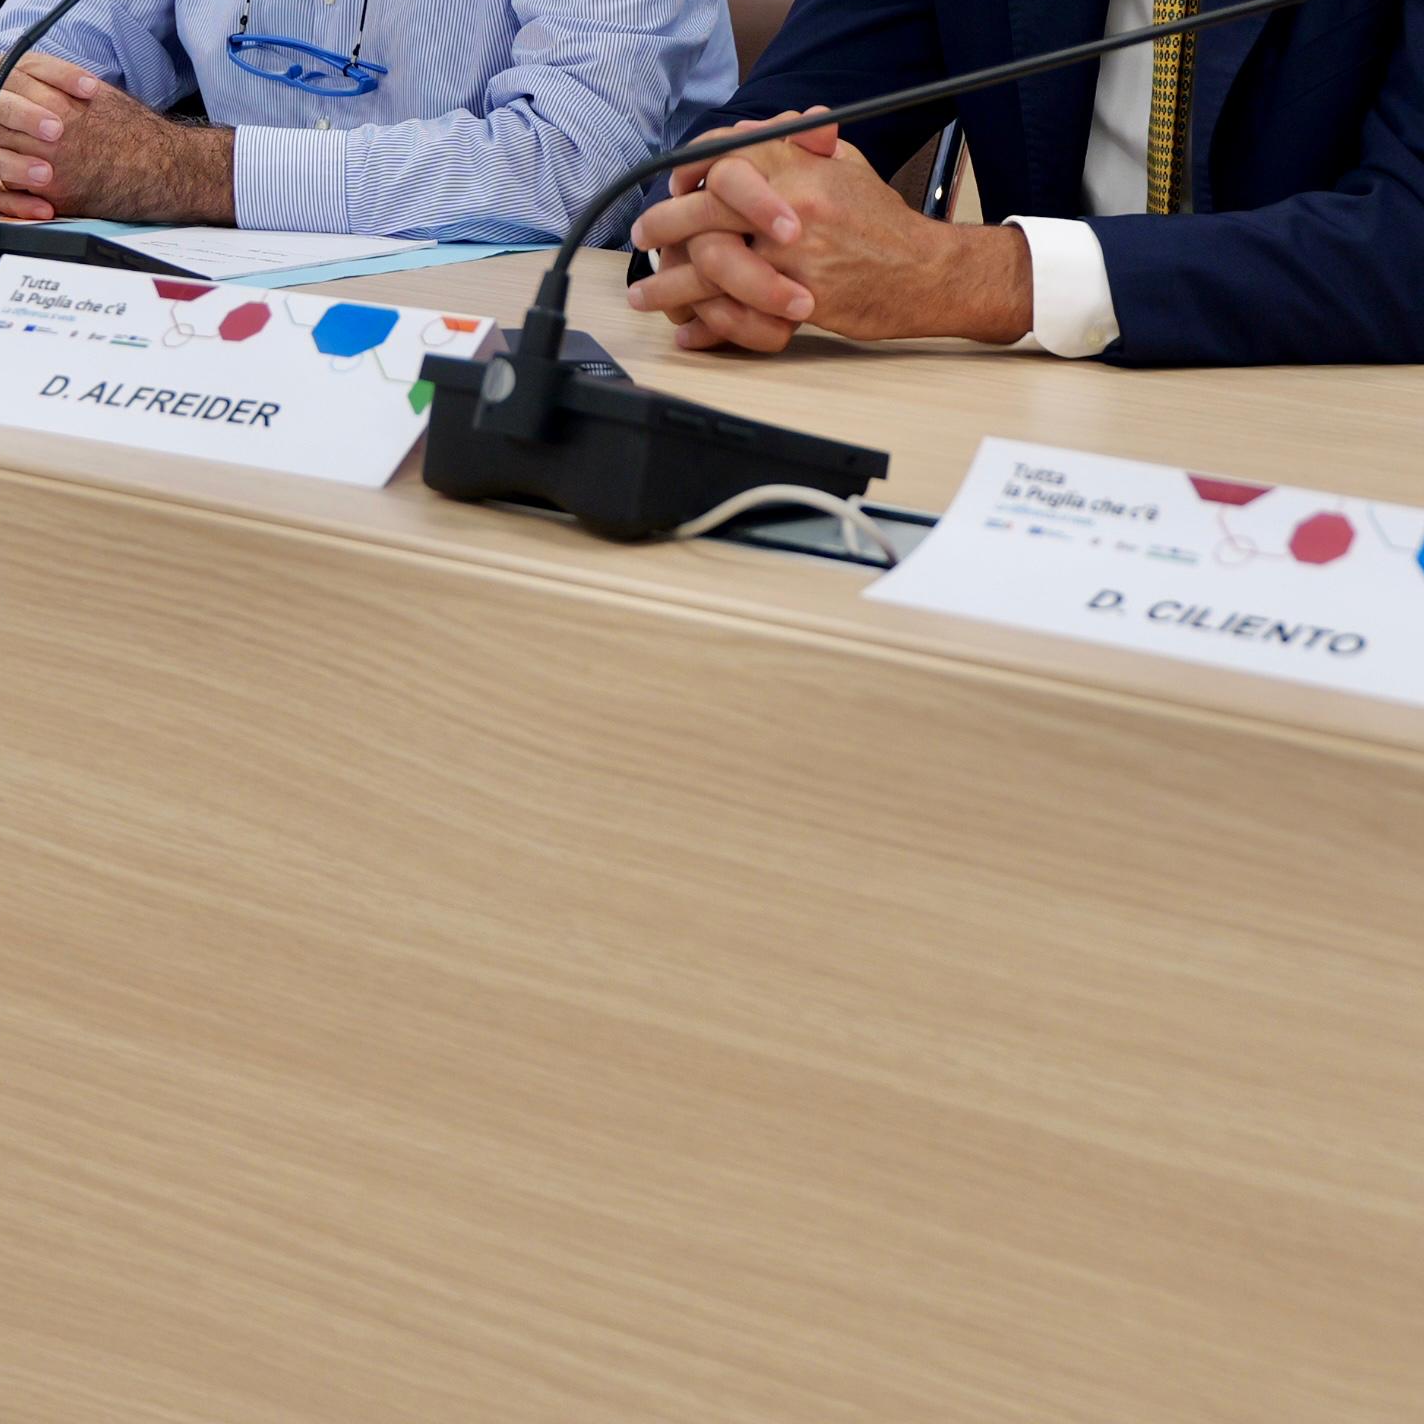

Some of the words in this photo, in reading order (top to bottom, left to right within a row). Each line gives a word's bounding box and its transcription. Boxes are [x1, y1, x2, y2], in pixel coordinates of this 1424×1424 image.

[20, 275, 61, 292] Tutta
[10, 289, 24, 303] la
[26, 292, 73, 310] Puglia
[75, 298, 103, 314] che
[104, 302, 128, 316] c'è
[39, 375, 71, 399] D.
[77, 380, 281, 428] ALFREIDER
[1013, 462, 1067, 485] Tutta
[1002, 481, 1021, 498] la
[1025, 484, 1086, 508] Puglia
[1090, 497, 1126, 515] che
[1147, 600, 1367, 655] CILIENTO
